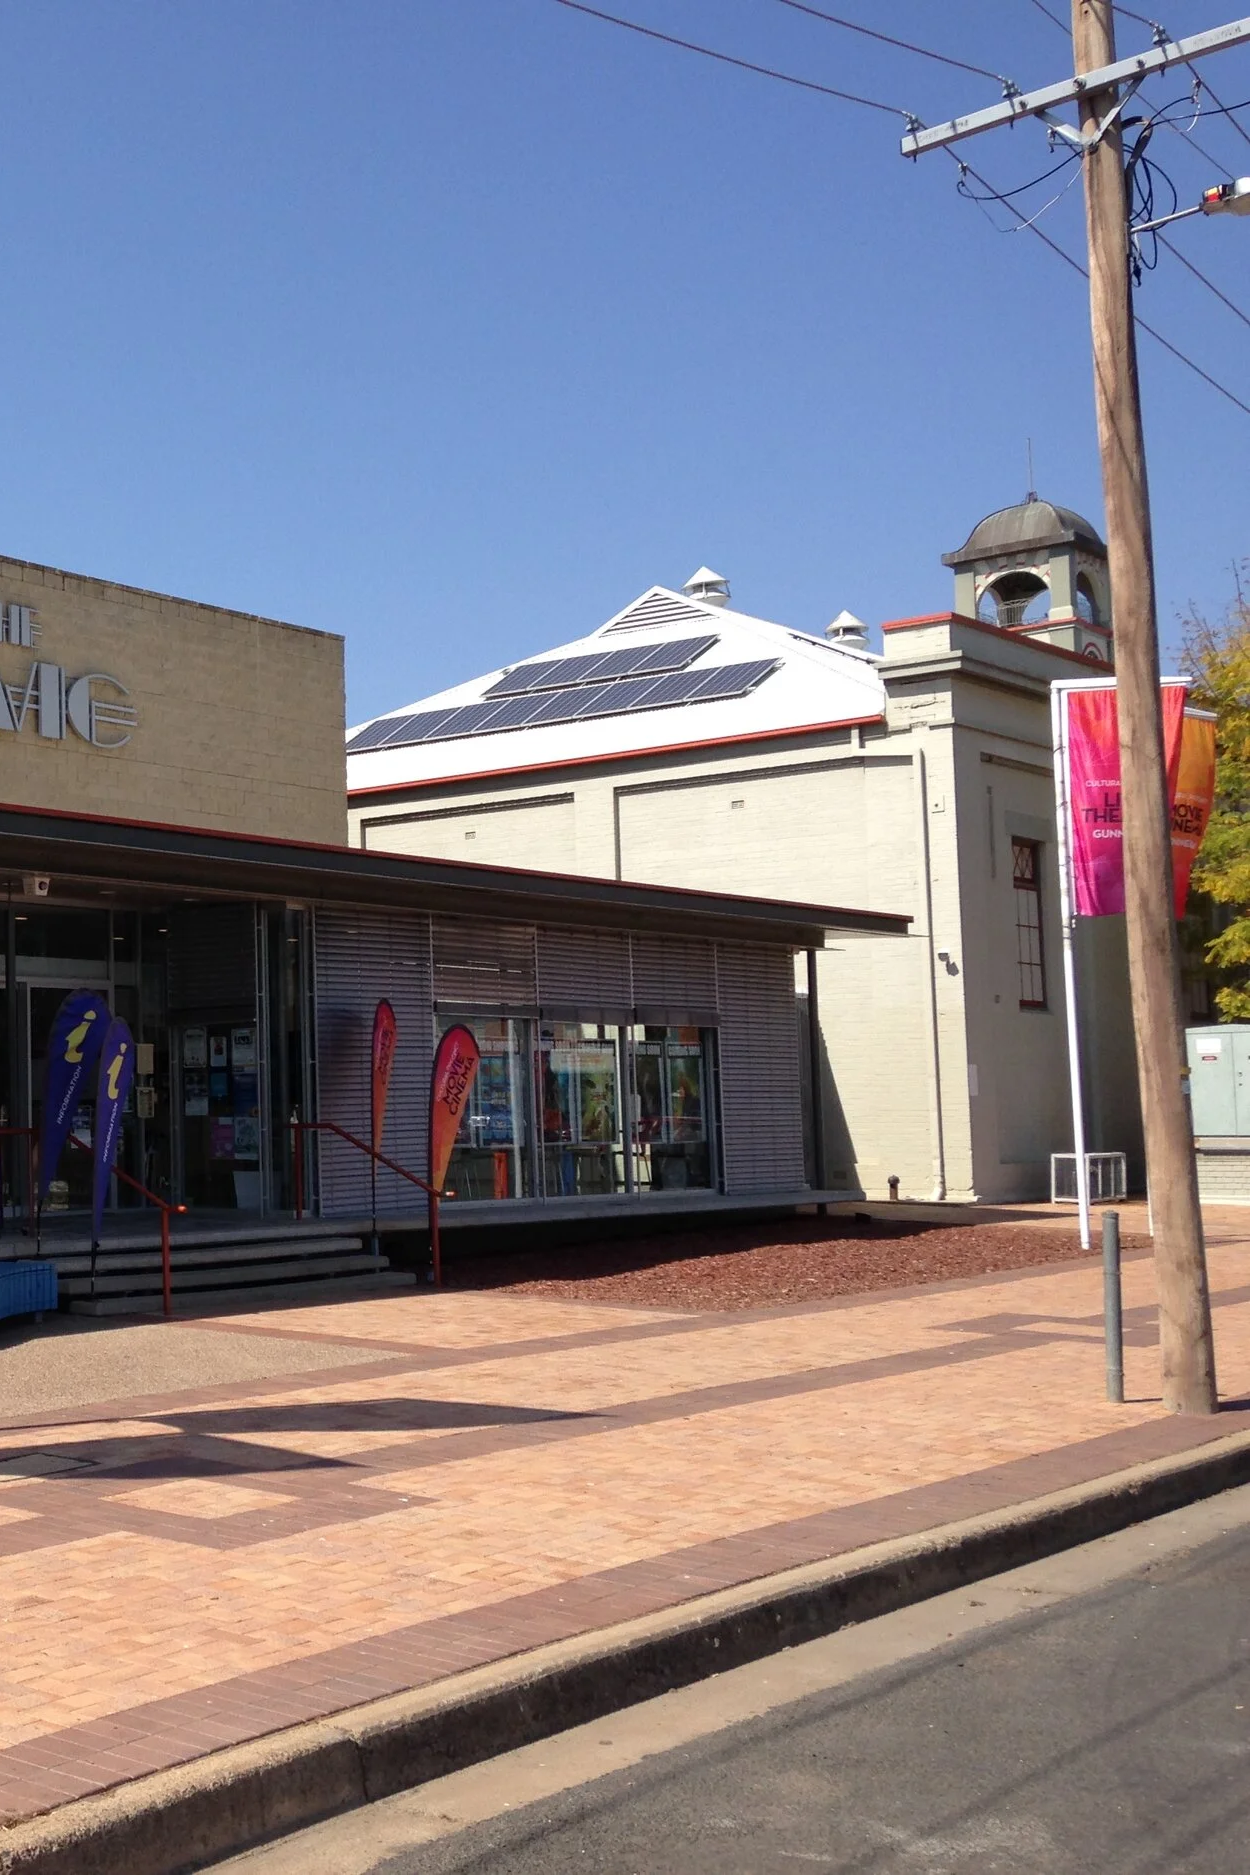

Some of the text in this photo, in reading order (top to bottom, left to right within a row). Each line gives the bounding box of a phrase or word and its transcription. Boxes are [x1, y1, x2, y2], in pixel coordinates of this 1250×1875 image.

[56, 1065, 83, 1125] INFORMATION
[443, 1056, 465, 1104] MOVIE
[448, 1057, 475, 1115] CINEMA
